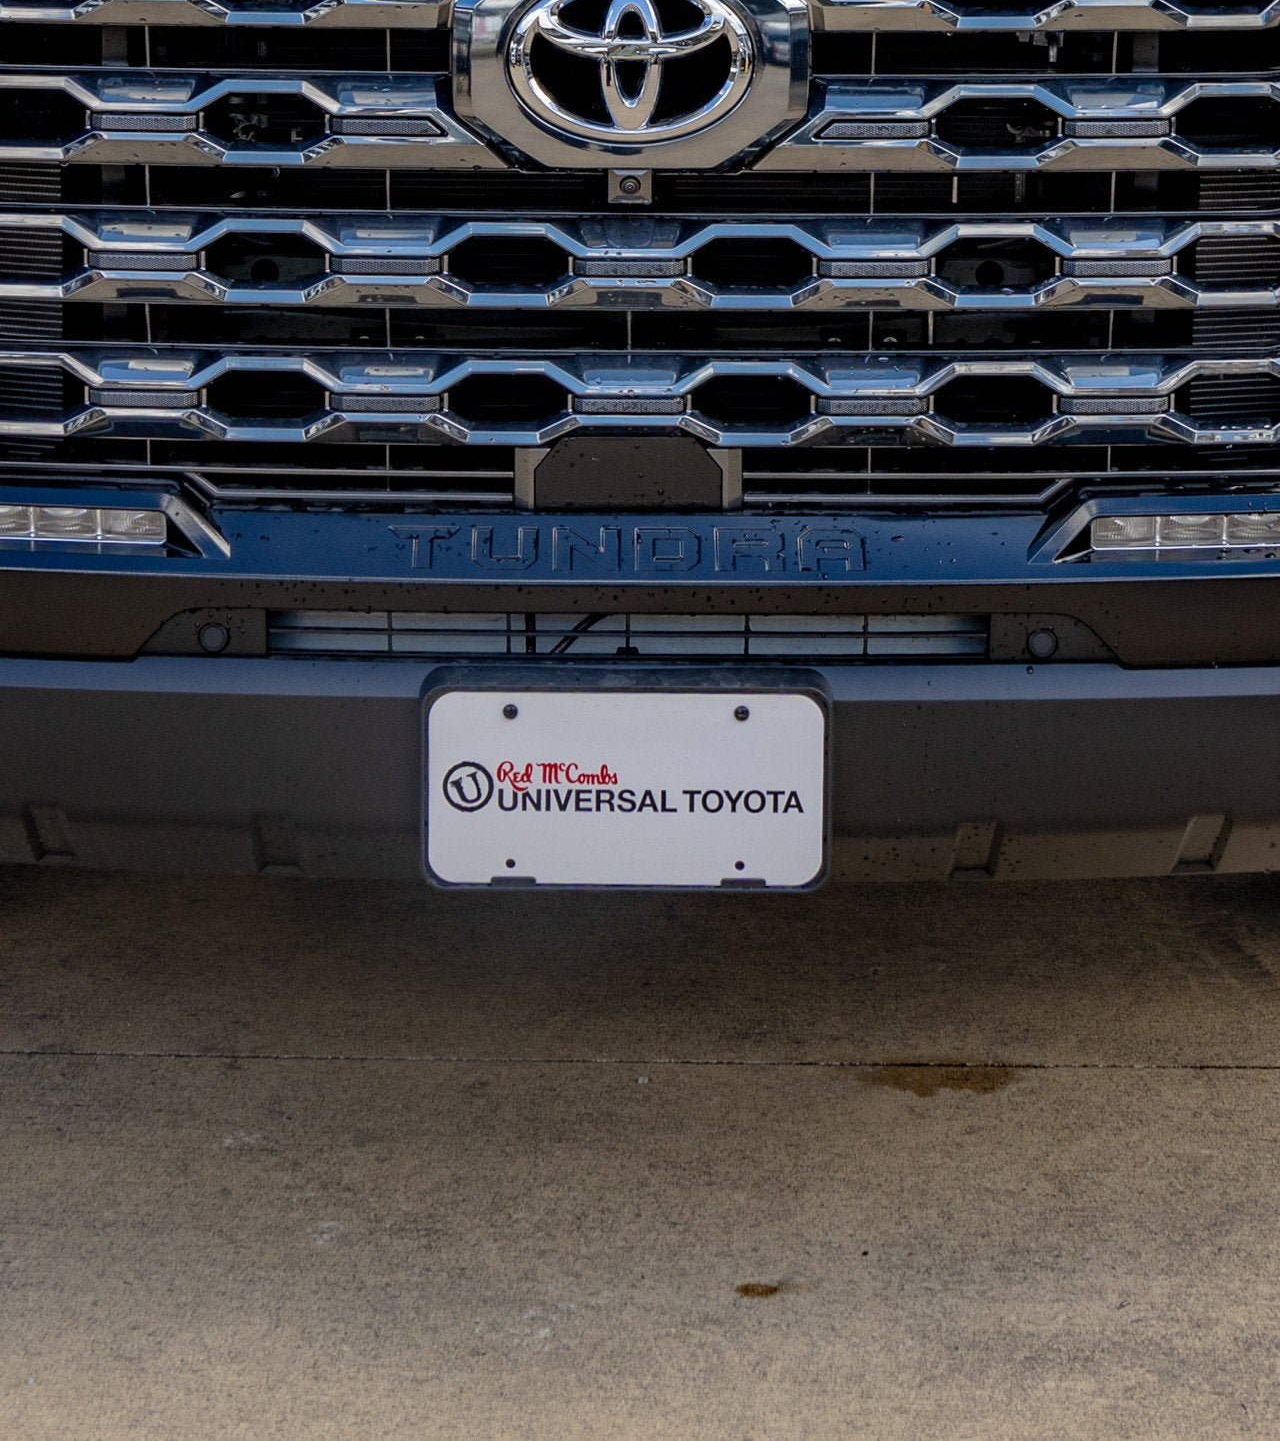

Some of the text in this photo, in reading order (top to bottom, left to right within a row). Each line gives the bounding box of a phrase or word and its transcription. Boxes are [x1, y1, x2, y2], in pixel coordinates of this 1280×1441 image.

[388, 525, 867, 572] TUNDRA
[496, 760, 619, 793] Red McCombs
[497, 787, 678, 814] UNIVERSAL
[682, 789, 804, 814] TOYOTA
